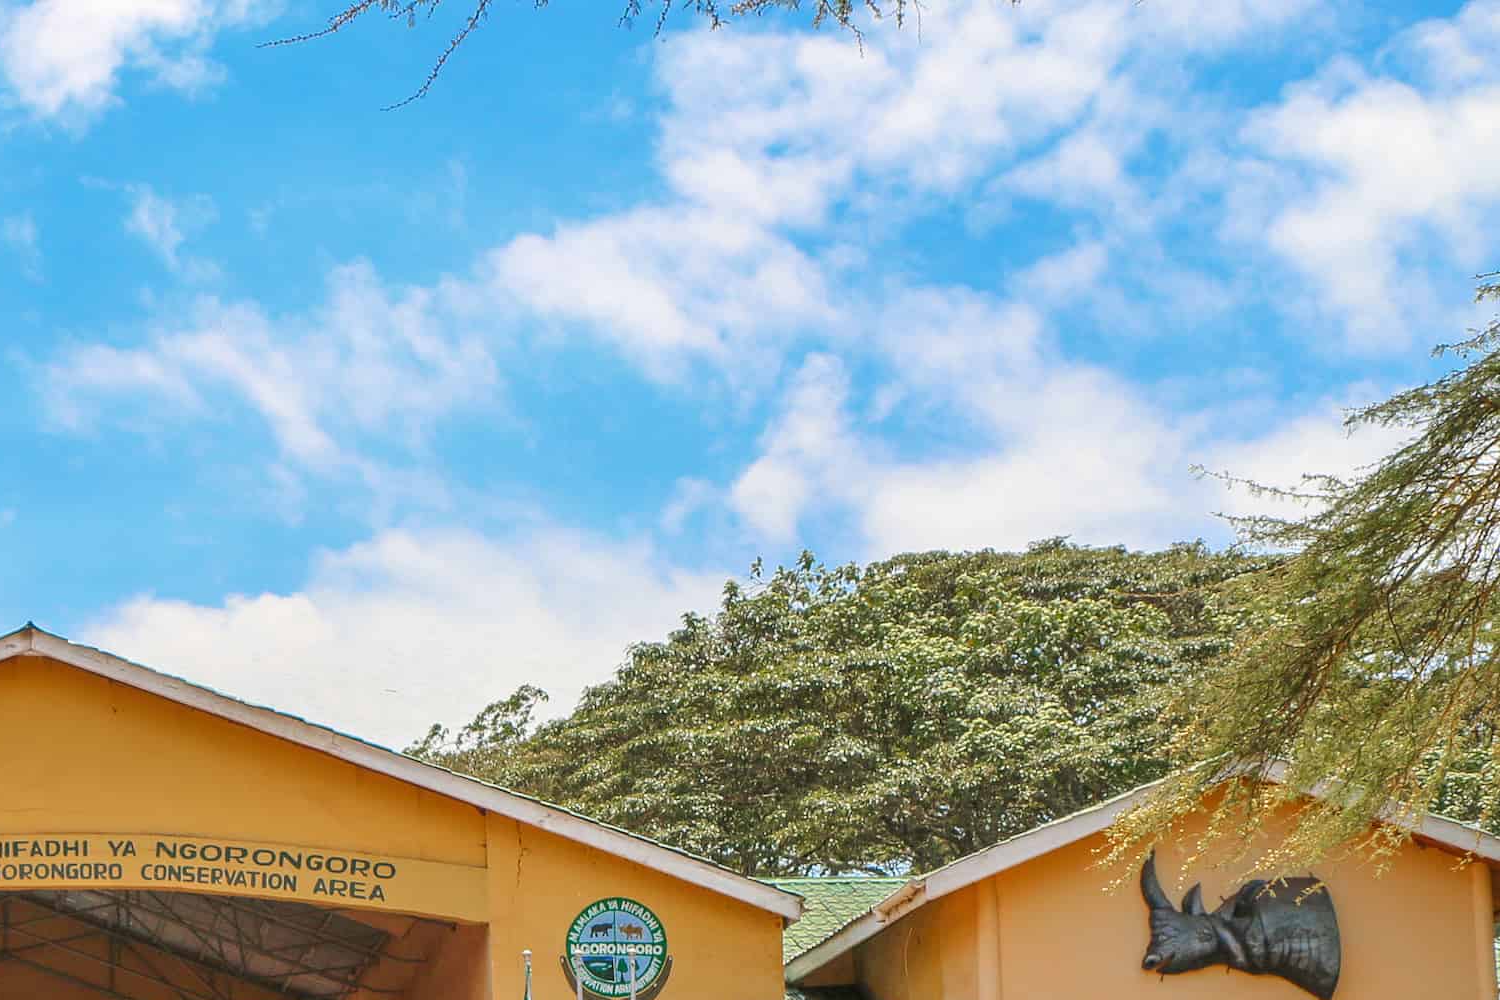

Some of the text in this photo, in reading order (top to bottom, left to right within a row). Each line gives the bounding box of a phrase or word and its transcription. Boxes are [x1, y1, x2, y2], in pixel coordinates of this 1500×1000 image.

[108, 840, 136, 857] YA
[156, 842, 396, 879] NGORONGORO
[141, 864, 297, 892] CONSERVATION
[313, 878, 386, 902] AREA
[568, 900, 664, 943] MAMLAKA YA HIFADHI YA
